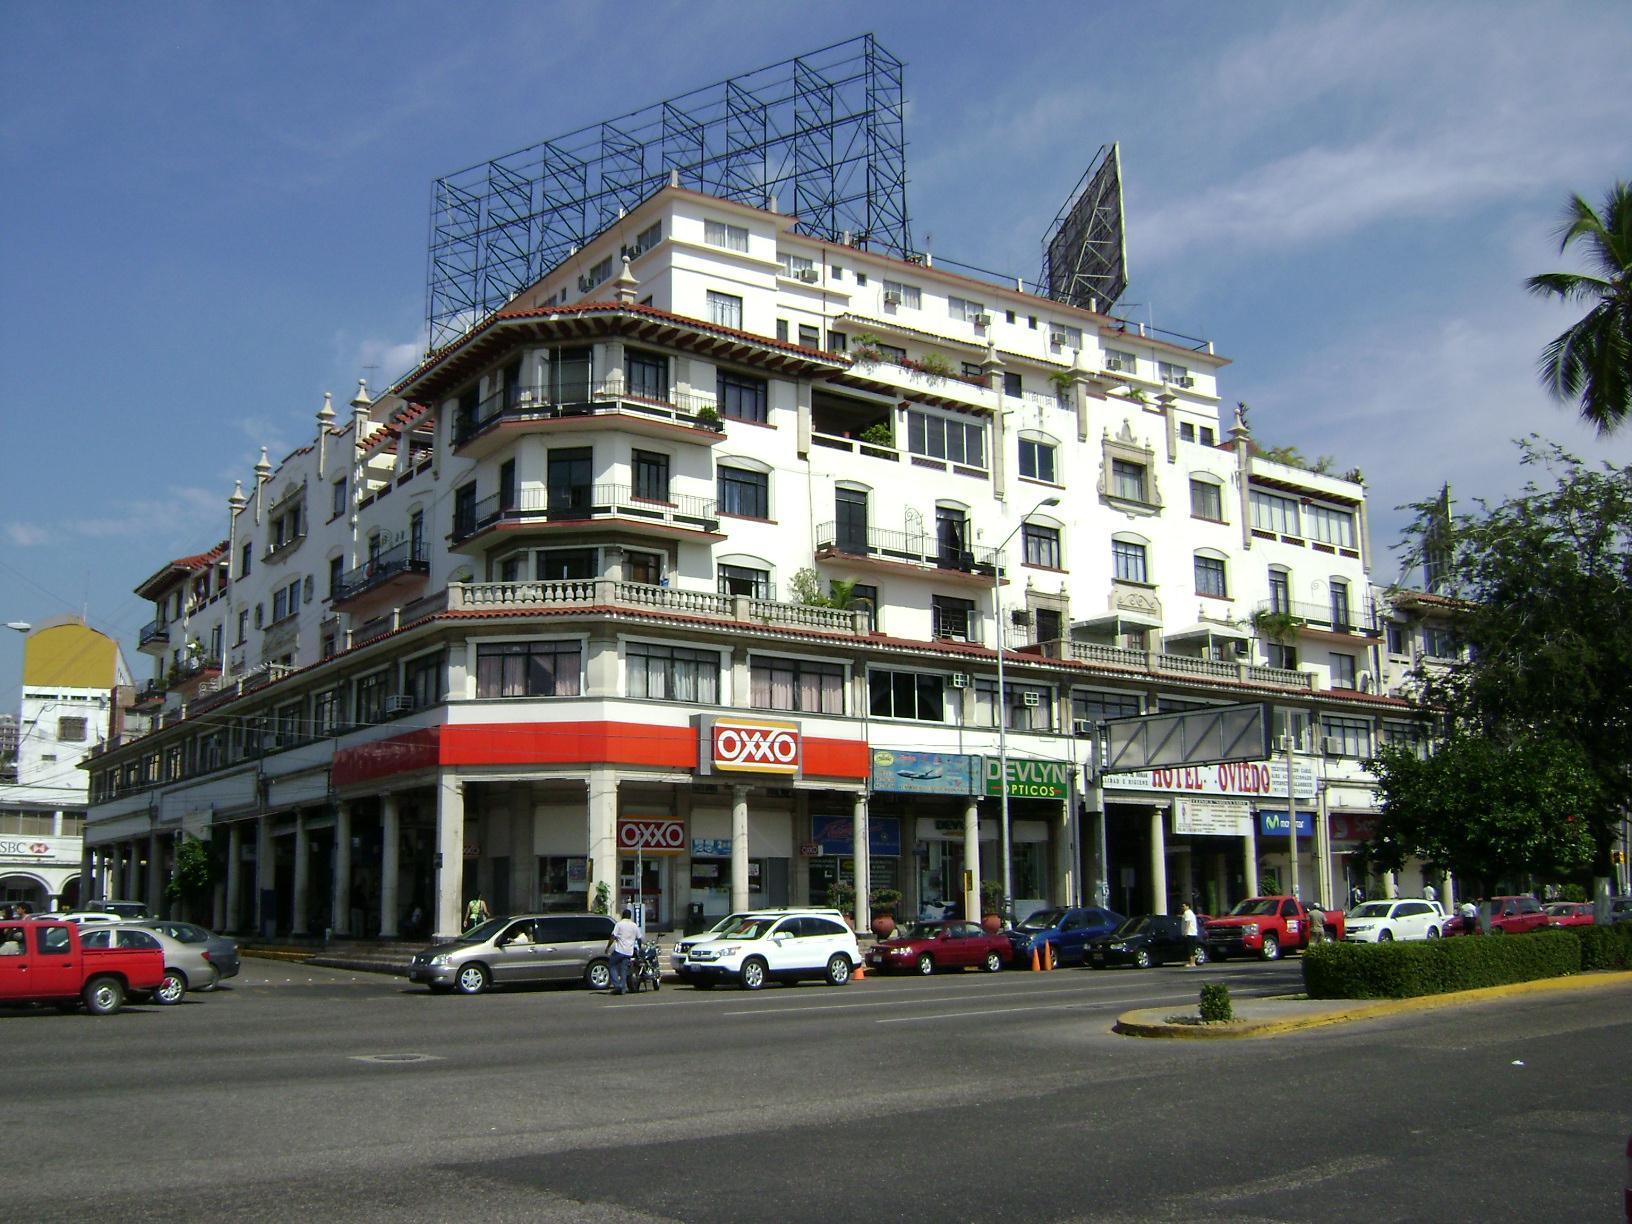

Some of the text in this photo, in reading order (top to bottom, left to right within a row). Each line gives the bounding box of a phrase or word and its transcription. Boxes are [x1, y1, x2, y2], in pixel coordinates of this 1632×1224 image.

[718, 730, 797, 763] OXXO
[987, 760, 1067, 784] DEVLYN
[1152, 762, 1270, 793] HOTEL OVIEDO
[621, 823, 684, 847] OXXO
